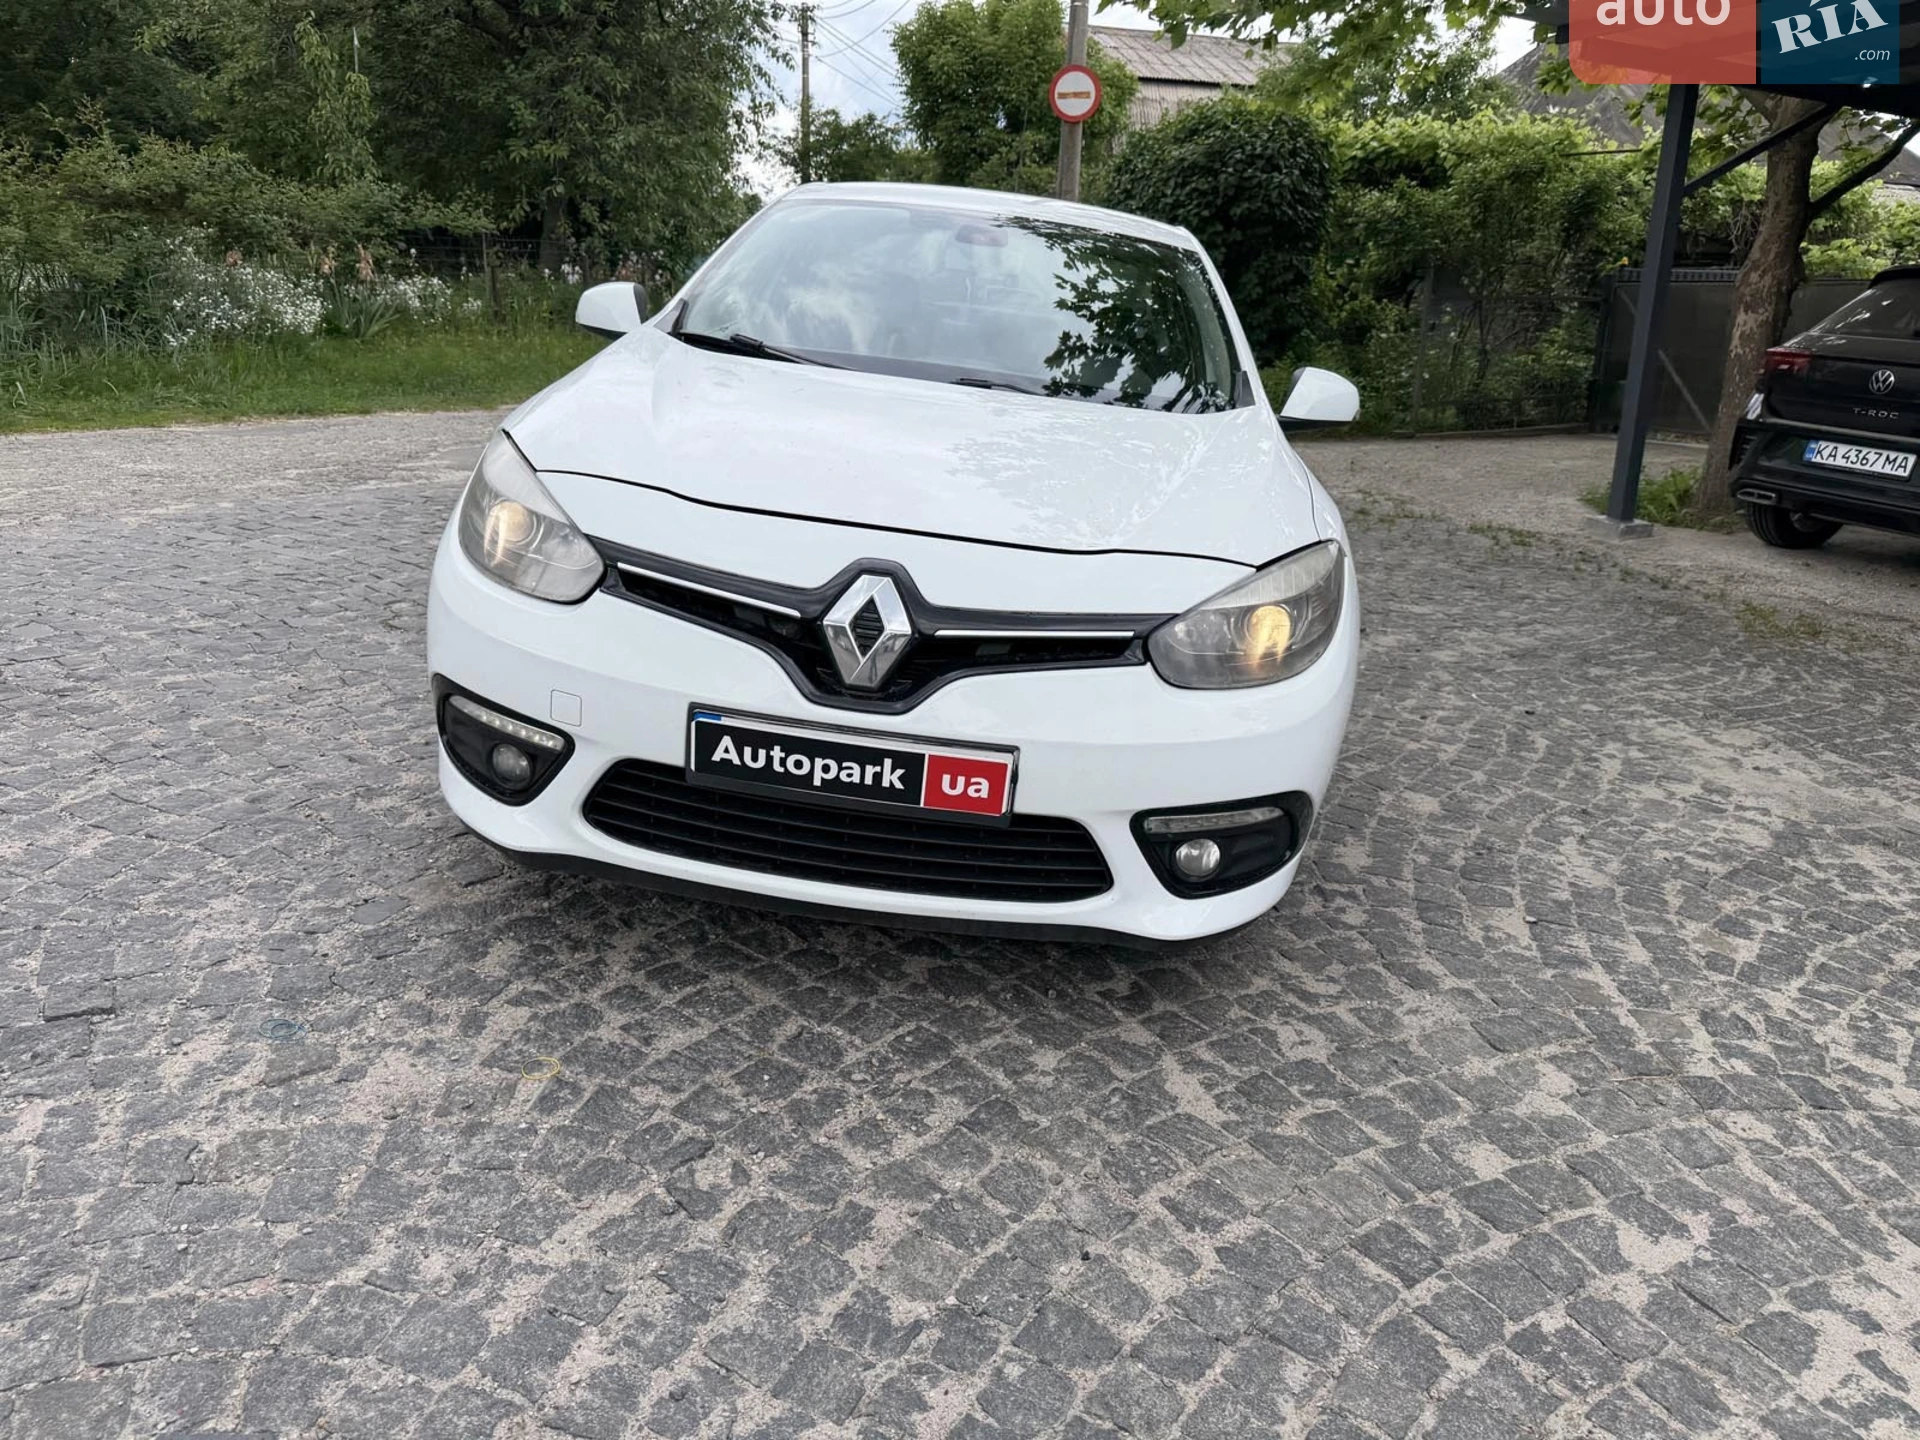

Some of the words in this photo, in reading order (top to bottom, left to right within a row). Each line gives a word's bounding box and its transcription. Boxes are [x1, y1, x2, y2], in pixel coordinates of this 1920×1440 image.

[1852, 407, 1899, 419] T-ROC
[1814, 443, 1839, 462] KA
[1841, 447, 1883, 468] 4367
[1881, 453, 1909, 474] MA
[711, 735, 906, 790] Autopark
[941, 773, 990, 799] ua
